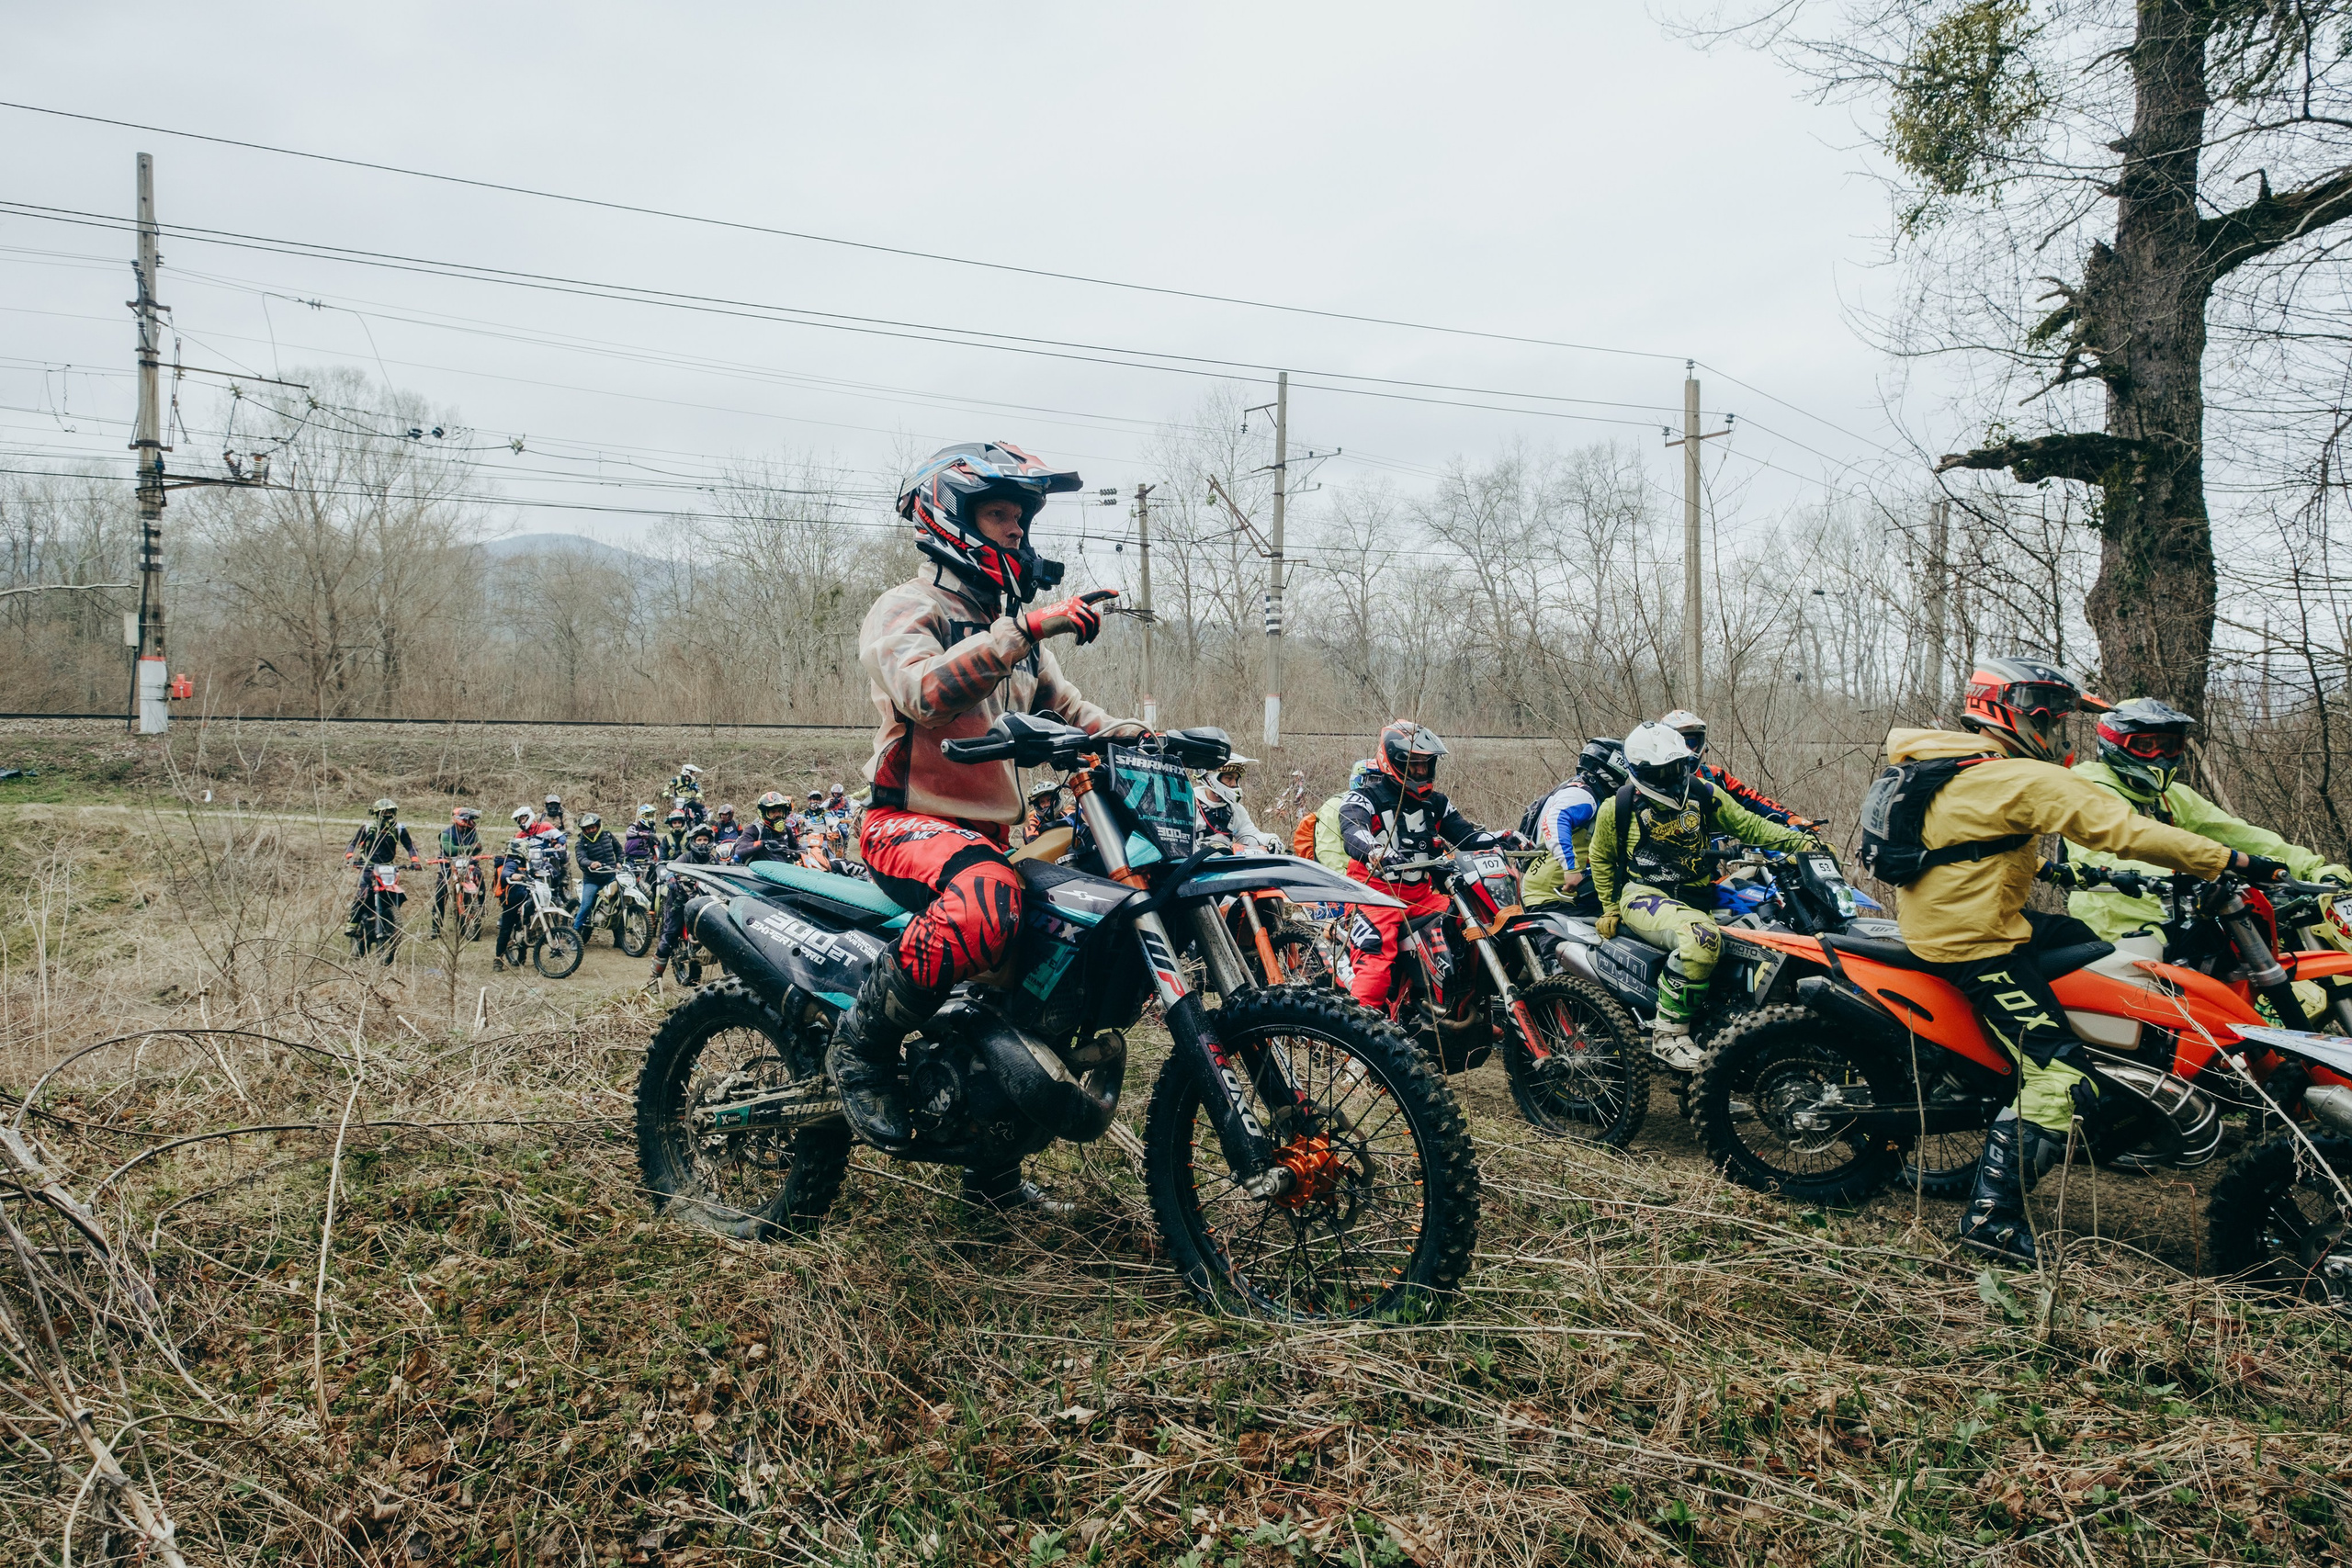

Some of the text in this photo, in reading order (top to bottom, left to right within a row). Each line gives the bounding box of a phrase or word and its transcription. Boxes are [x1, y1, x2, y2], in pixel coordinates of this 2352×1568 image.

[1114, 754, 1186, 777] SHARMAX
[1115, 767, 1195, 818] 714
[1482, 859, 1499, 870] 107
[1818, 863, 1832, 873] 53
[750, 919, 827, 965] EXPERT PRO
[763, 910, 839, 954] 300
[1976, 970, 2060, 1031] FOX
